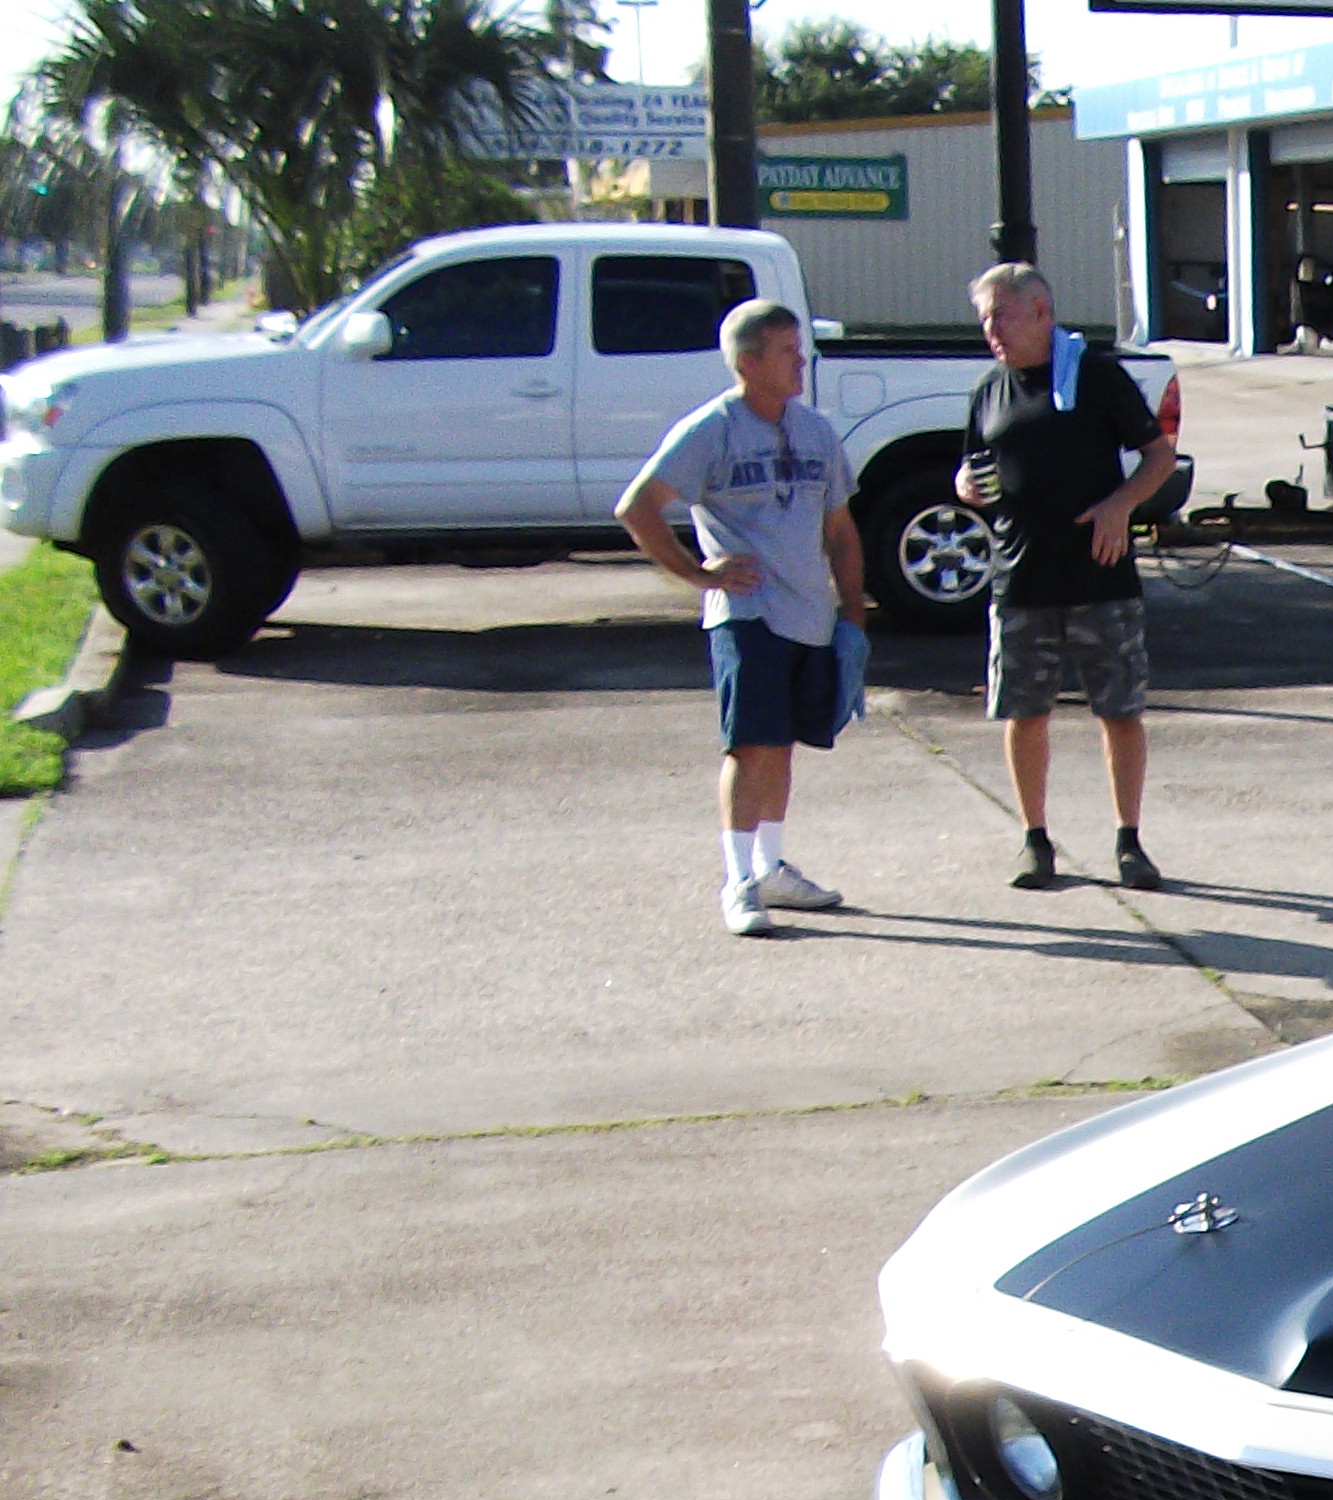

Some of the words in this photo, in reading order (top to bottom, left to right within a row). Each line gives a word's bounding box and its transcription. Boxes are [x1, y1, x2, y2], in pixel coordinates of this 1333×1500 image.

[757, 164, 820, 187] PAYDAY
[823, 165, 900, 189] ADVANCE
[728, 461, 768, 489] AIR
